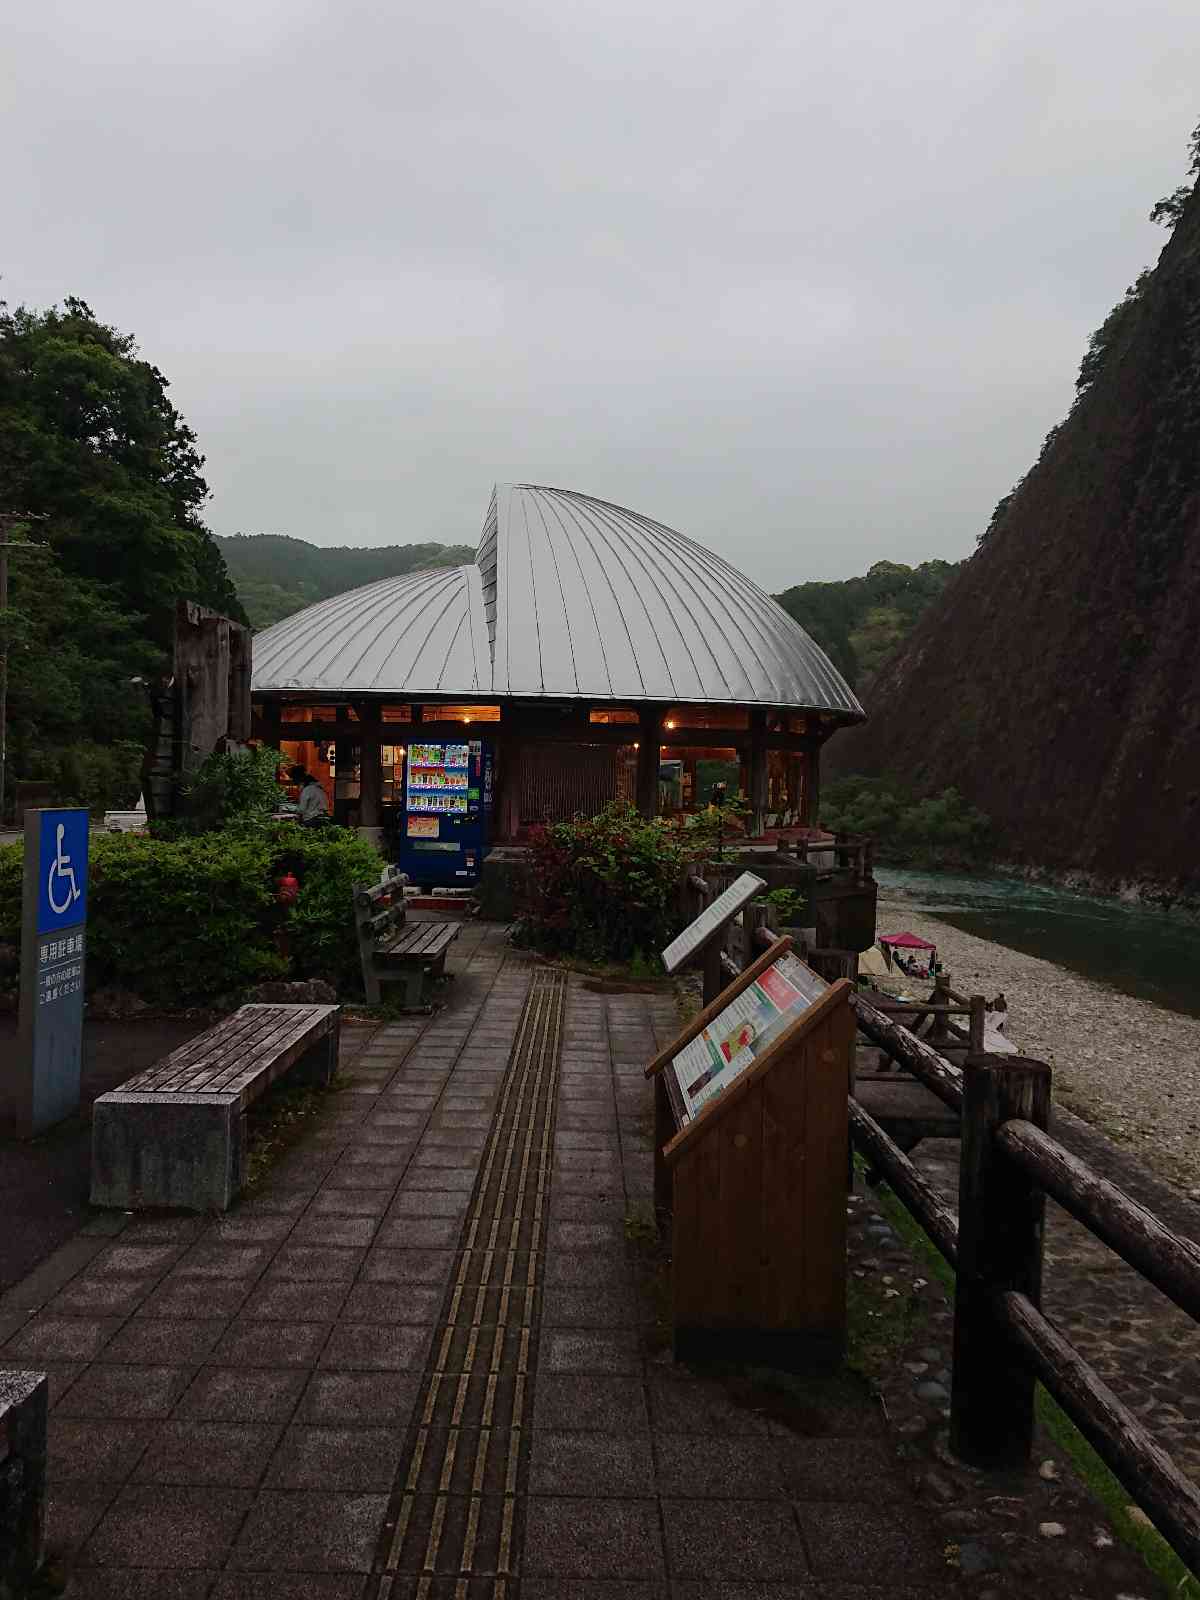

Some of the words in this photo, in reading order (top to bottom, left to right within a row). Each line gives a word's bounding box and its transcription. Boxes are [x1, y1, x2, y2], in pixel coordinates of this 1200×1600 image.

[40, 934, 82, 961] 専用駐車場
